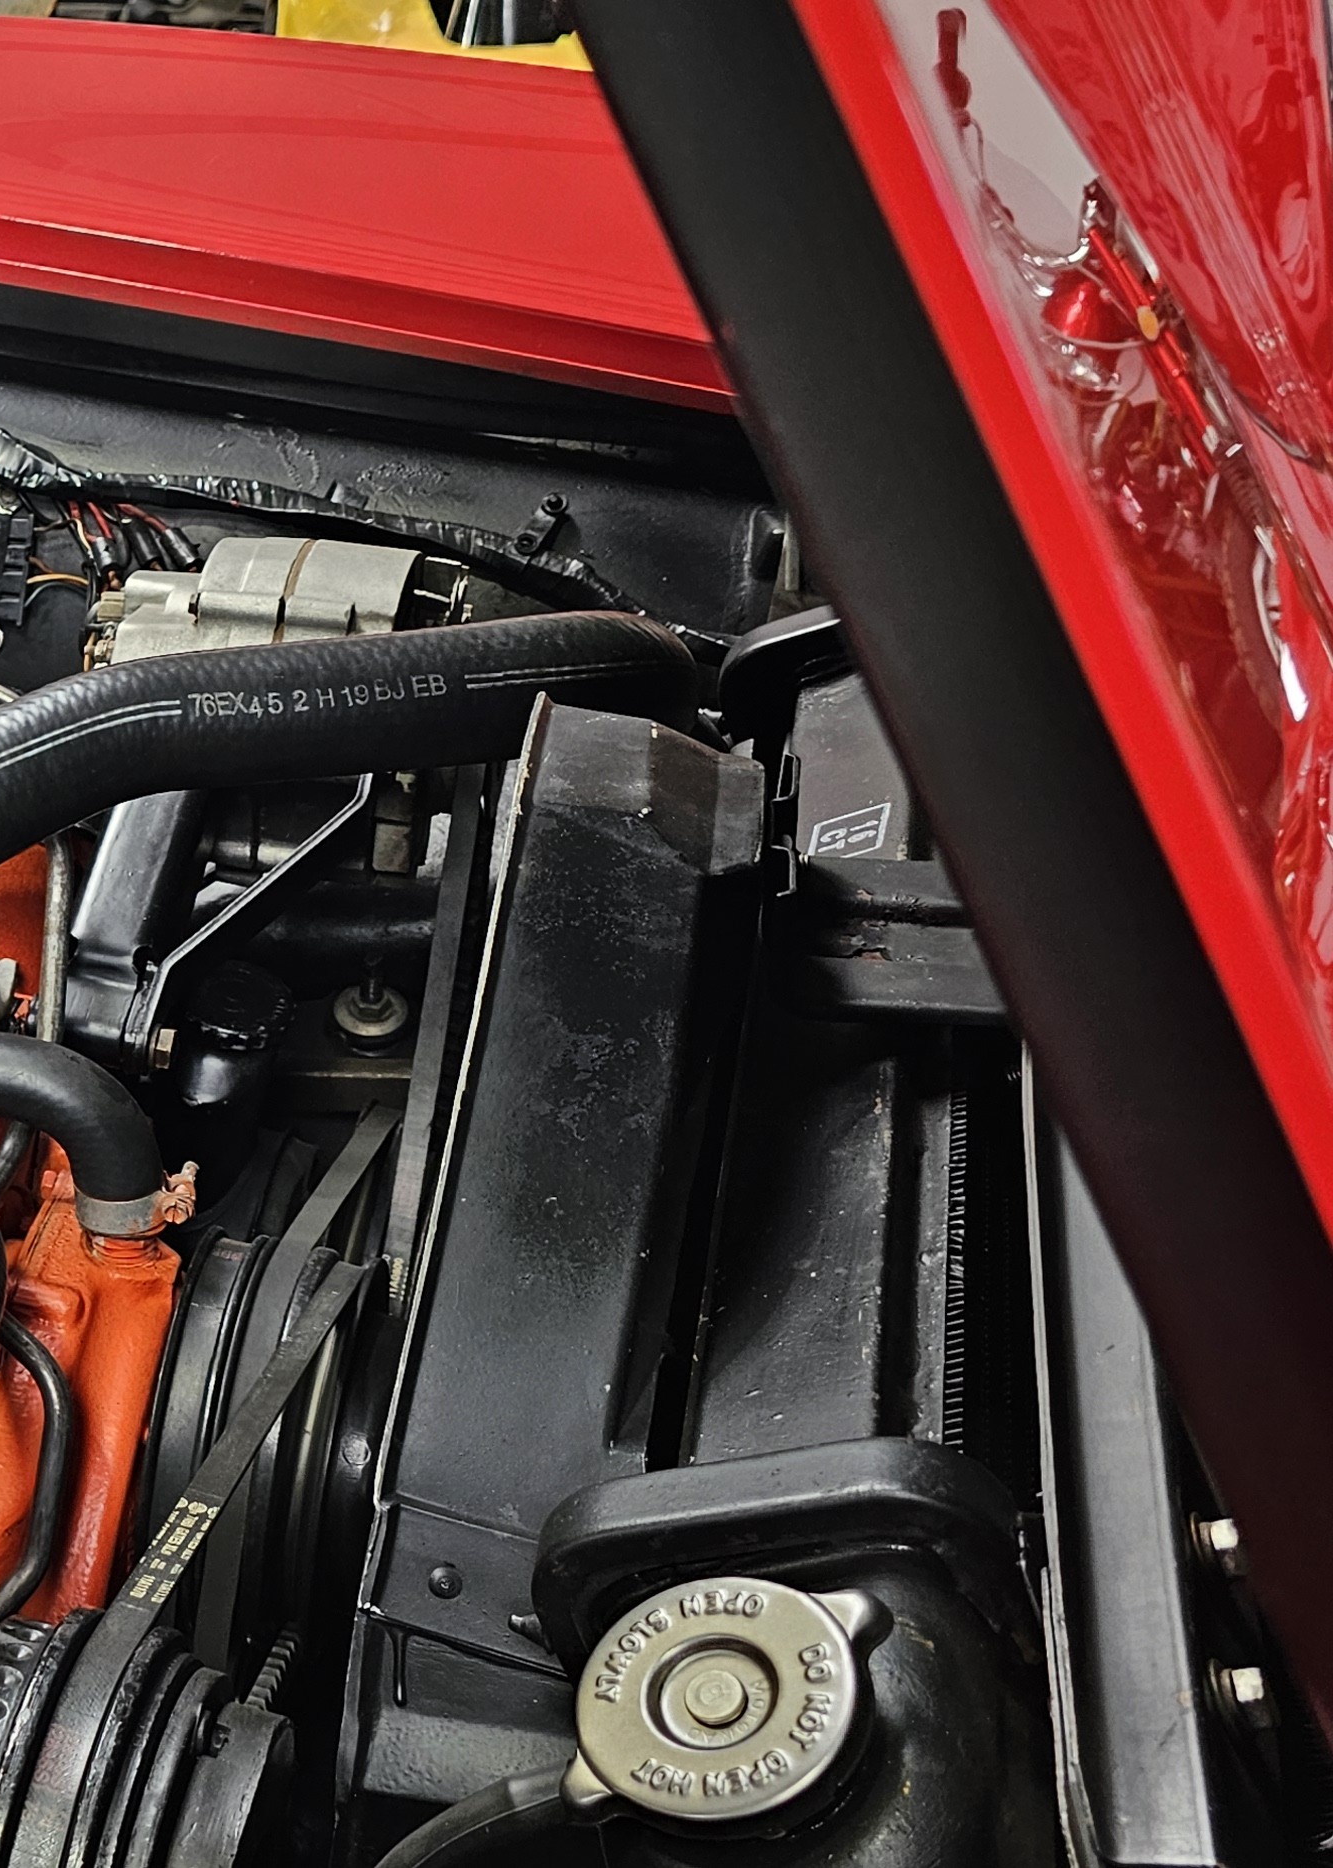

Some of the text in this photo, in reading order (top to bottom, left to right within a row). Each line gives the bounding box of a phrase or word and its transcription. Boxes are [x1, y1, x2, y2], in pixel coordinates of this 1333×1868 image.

[411, 674, 448, 698] EB
[594, 1590, 765, 1704] OPEN SLOWLY
[630, 1642, 833, 1798] DO NOT OPEN HOT
